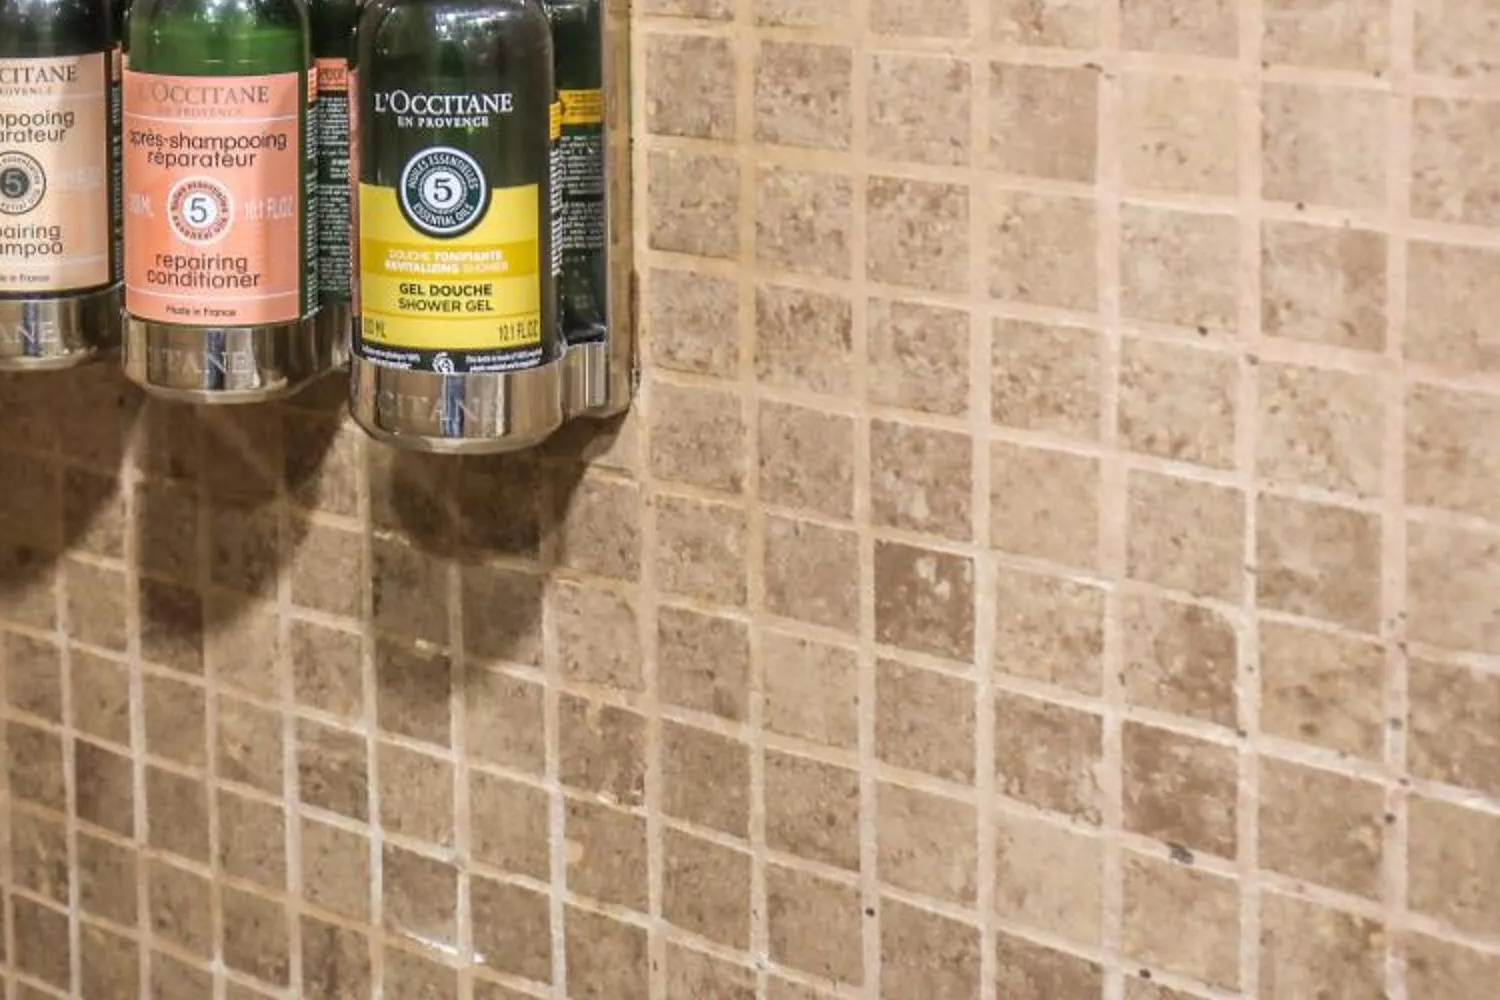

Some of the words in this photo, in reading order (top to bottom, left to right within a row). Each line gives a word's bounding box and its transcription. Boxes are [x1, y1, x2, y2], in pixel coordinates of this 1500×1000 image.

[374, 89, 514, 115] L'OCCITANE
[397, 116, 413, 128] EN
[417, 116, 489, 129] PROVENCE
[5, 171, 22, 197] 5
[433, 178, 453, 203] 5
[190, 197, 207, 223] 5
[155, 253, 248, 273] repairing
[147, 269, 260, 289] conditioner
[399, 283, 426, 296] GEL
[429, 283, 493, 297] DOUCHE
[398, 298, 461, 313] SHOWER
[465, 299, 494, 312] GEL
